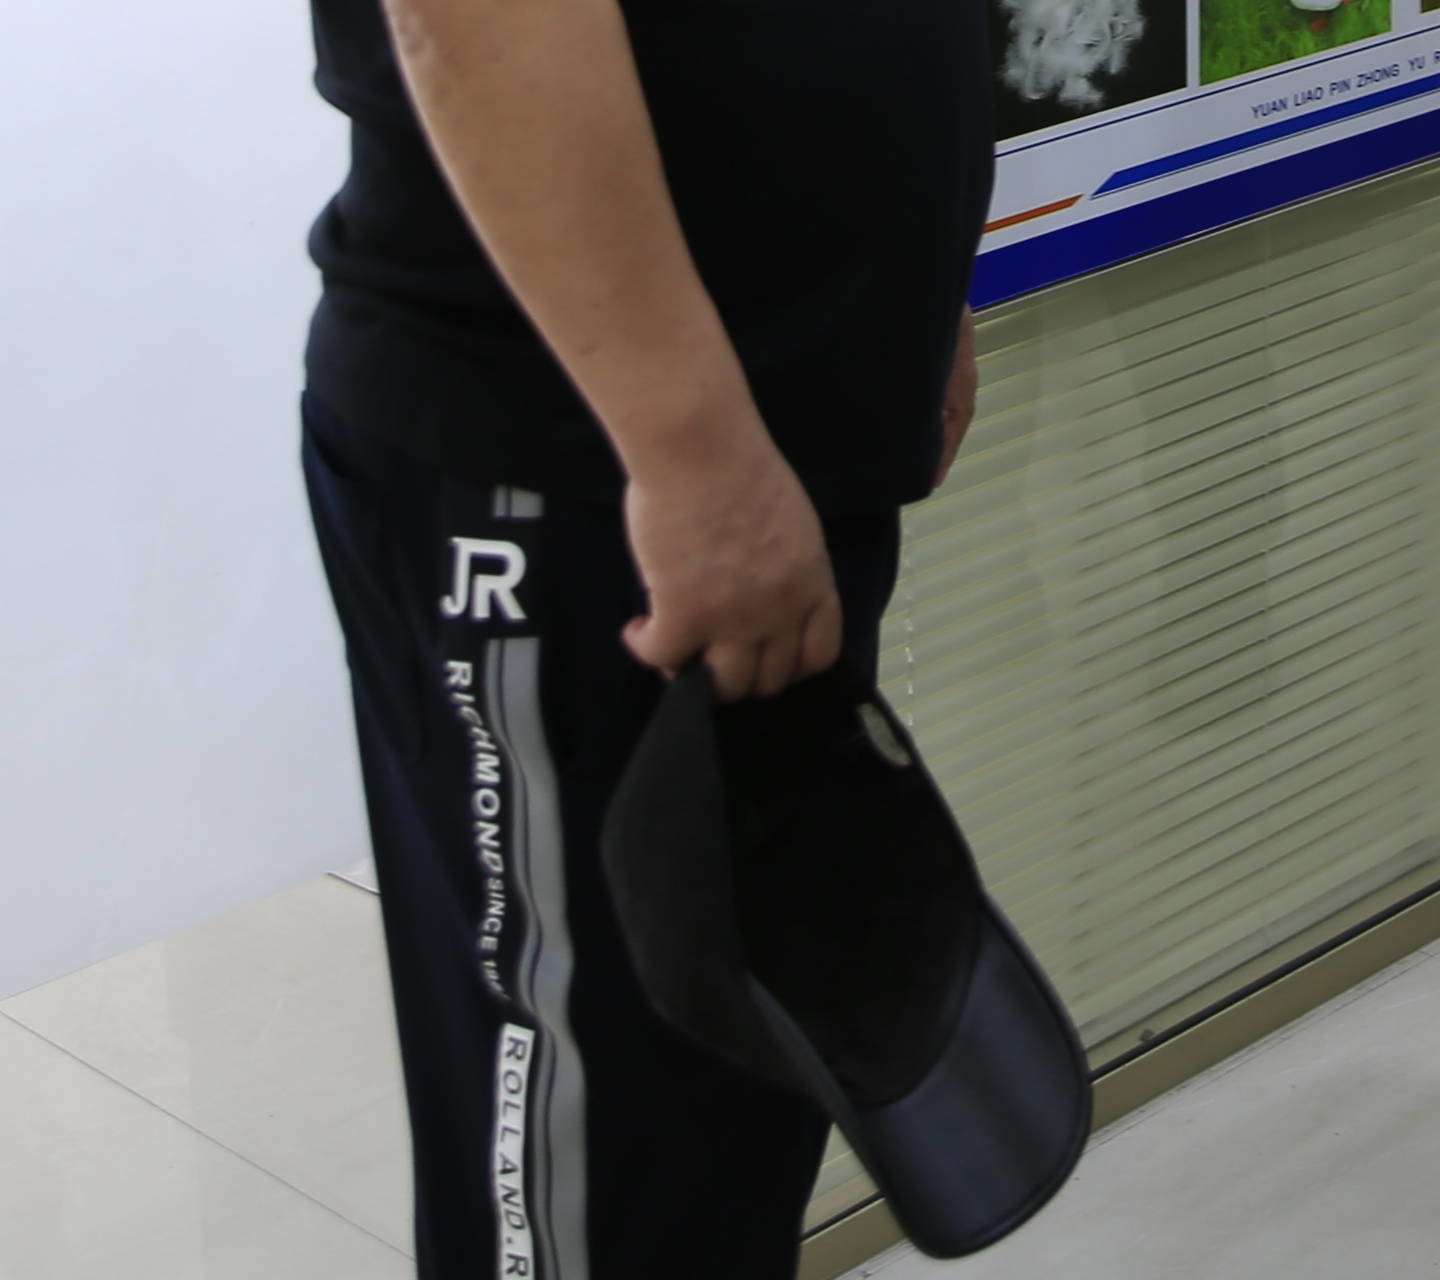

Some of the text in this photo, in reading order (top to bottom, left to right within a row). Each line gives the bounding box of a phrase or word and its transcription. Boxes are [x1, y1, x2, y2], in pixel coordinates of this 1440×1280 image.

[1251, 97, 1290, 119] YUAN
[1293, 86, 1324, 107] LIAO
[1329, 78, 1352, 97] PIN
[1356, 63, 1401, 89] ZHONG
[1407, 55, 1426, 72] YU
[445, 659, 505, 874] RICHMOND
[480, 877, 506, 951] SINCE
